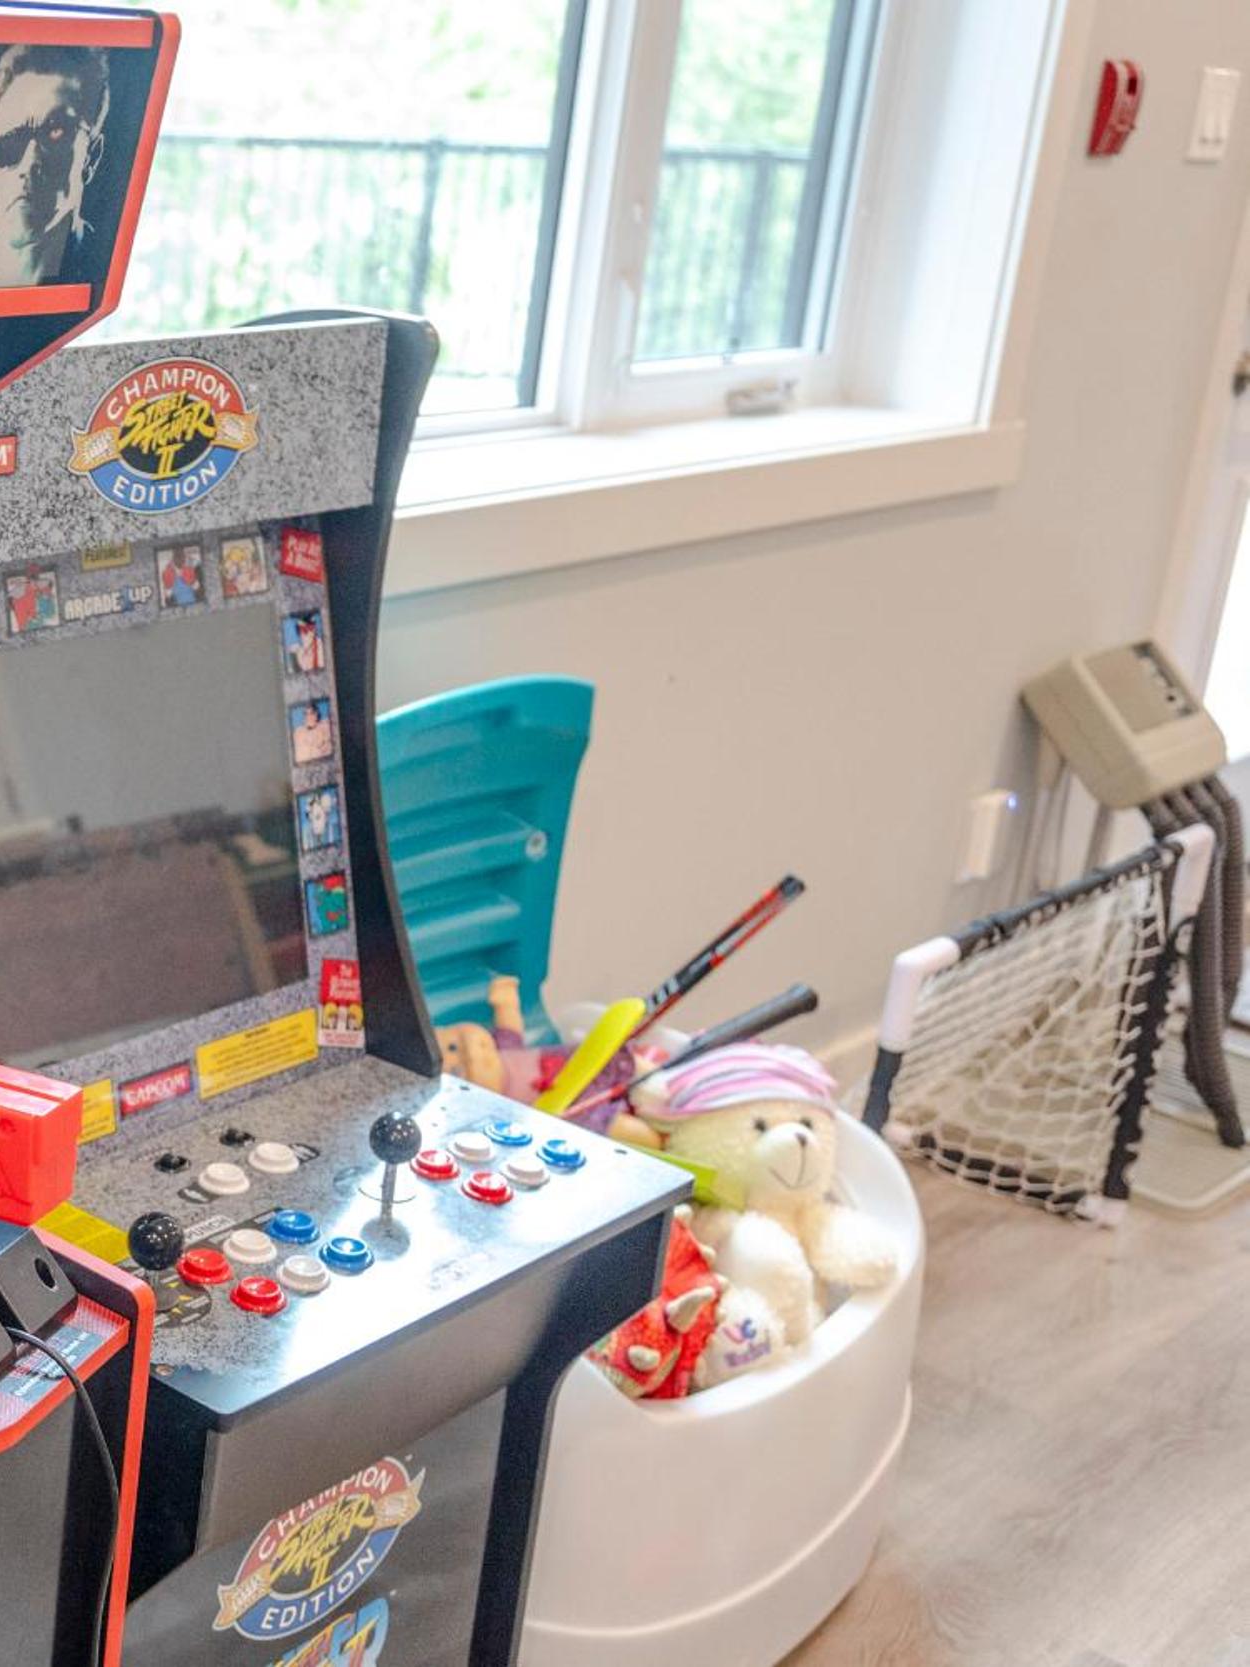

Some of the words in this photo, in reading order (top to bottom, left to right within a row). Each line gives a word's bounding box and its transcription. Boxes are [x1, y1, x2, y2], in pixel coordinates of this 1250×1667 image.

[106, 368, 231, 420] CHAMPION
[113, 460, 218, 505] EDITION
[125, 1073, 188, 1106] CAPCOM
[261, 1547, 376, 1629] EDITION
